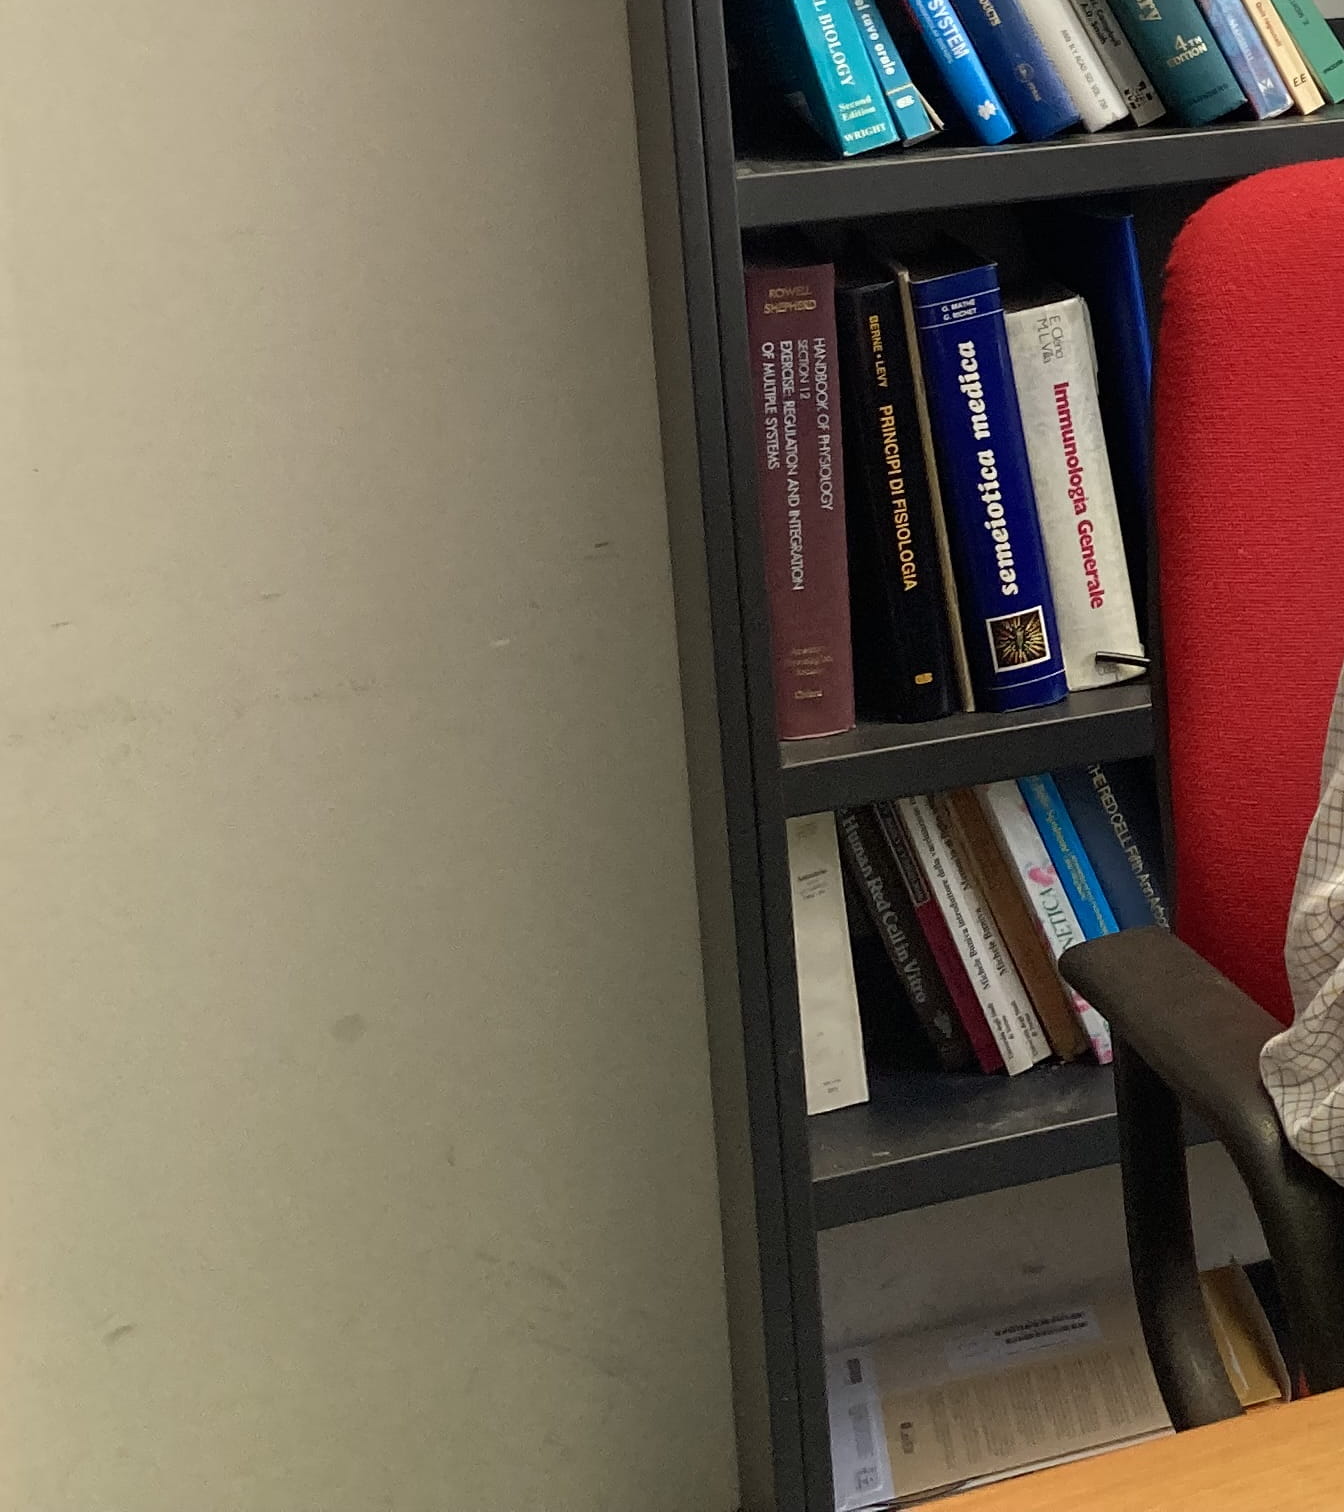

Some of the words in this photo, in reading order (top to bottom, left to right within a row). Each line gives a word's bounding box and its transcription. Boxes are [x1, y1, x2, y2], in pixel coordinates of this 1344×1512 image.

[818, 12, 853, 87] BIOLOGY
[1167, 42, 1208, 68] EDITION
[838, 95, 872, 110] Second
[844, 123, 886, 141] WRIGHT
[761, 342, 774, 358] OF
[798, 339, 808, 382] SECTION
[814, 337, 827, 410] HANDBOOK
[869, 315, 881, 351] BERNE
[875, 360, 886, 388] LEVY
[764, 363, 775, 413] MULTIPLE
[799, 388, 810, 399] 12
[954, 340, 988, 440] medica
[766, 417, 778, 468] SYSTEMS
[817, 416, 829, 430] OF
[879, 405, 900, 474] PRINCIPI
[818, 434, 831, 510] PHYSIOLOGY
[888, 478, 904, 495] DI
[1051, 382, 1088, 515] Immunologia
[1077, 518, 1105, 609] Generale
[892, 498, 917, 591] FISIOLOGIA
[973, 449, 1016, 596] semeiotica
[842, 816, 878, 880] Human
[867, 876, 891, 911] Red
[881, 909, 905, 945] Cell
[893, 941, 913, 962] in
[902, 959, 930, 1003] Vitro
